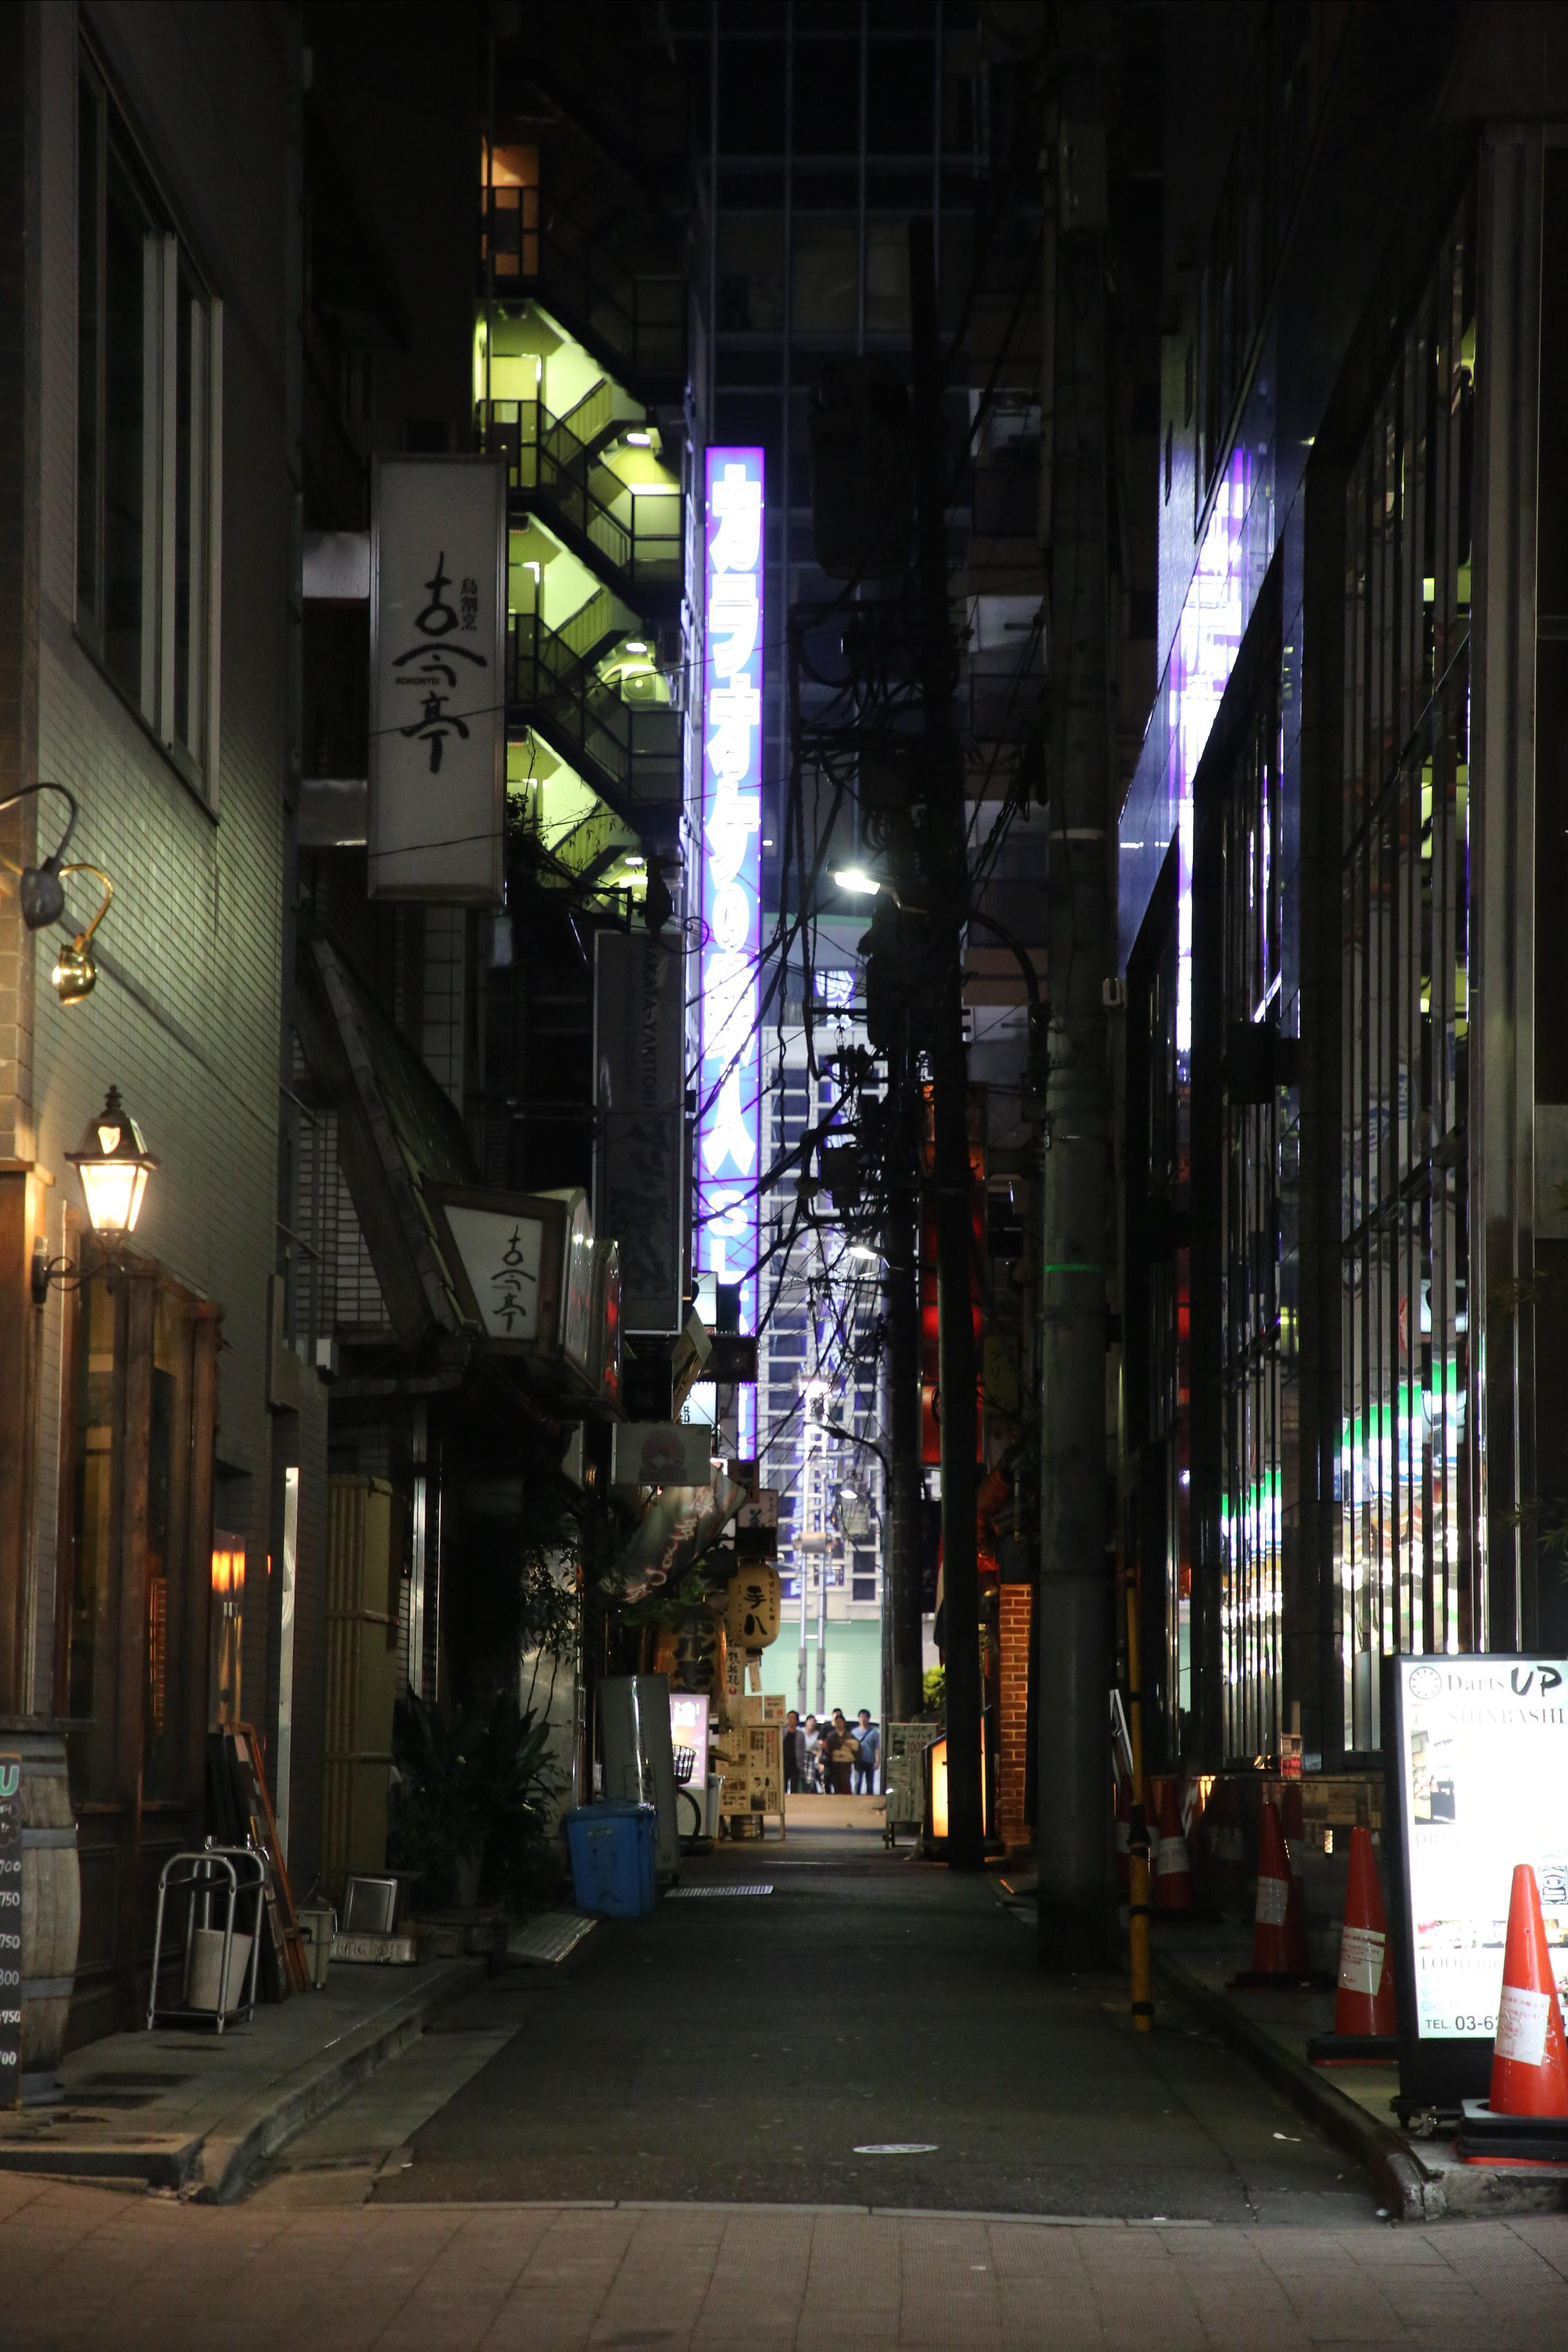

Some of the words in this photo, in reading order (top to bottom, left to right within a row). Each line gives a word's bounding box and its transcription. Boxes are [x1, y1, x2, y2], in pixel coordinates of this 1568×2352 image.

[393, 550, 487, 774] 古今亭
[396, 676, 439, 685] KOKONTEI
[491, 1225, 536, 1332] 古今亭
[1447, 1674, 1505, 1691] Darts
[1510, 1665, 1563, 1697] UP
[1425, 2019, 1451, 2029] TEL.
